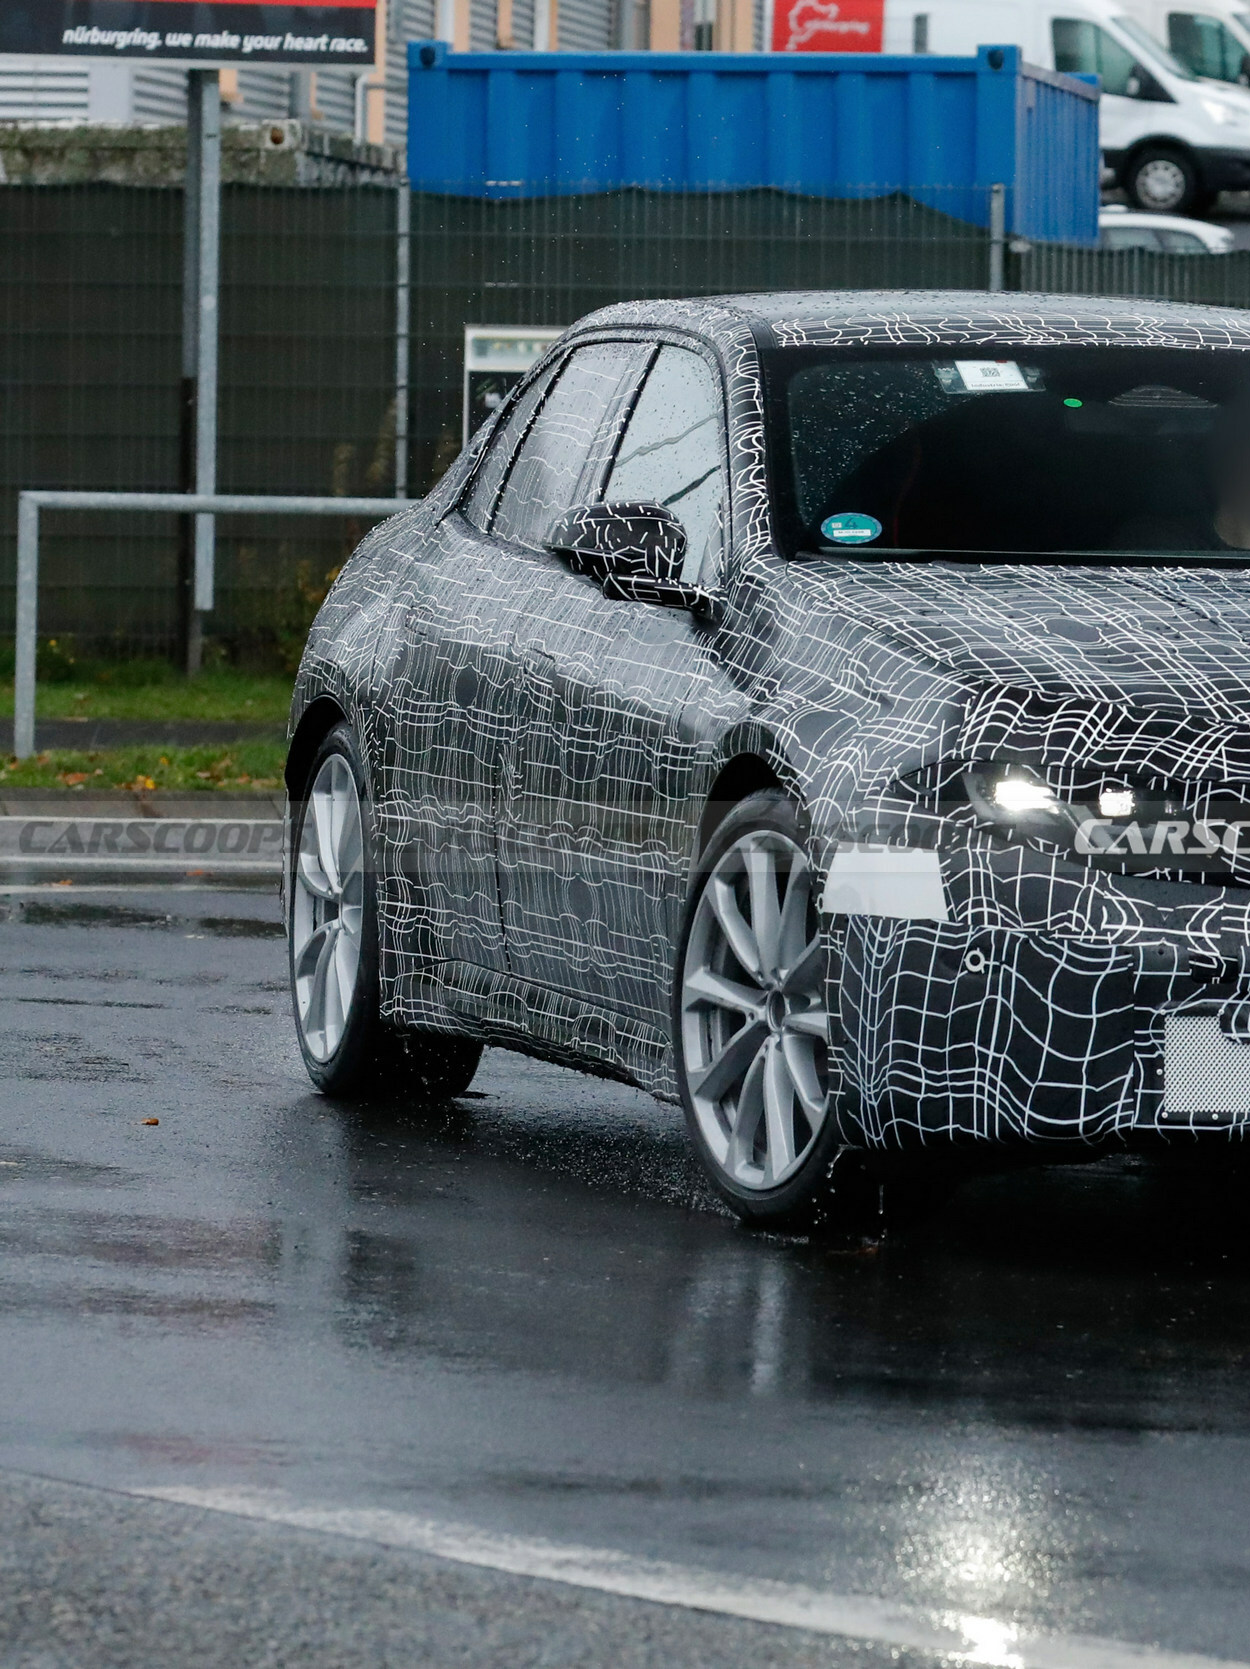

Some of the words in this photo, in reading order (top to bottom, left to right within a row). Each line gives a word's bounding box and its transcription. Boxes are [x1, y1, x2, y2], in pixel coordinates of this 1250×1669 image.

[62, 25, 163, 51] nürburgring.
[164, 32, 193, 48] we
[194, 30, 241, 49] make
[241, 34, 283, 54] your
[283, 32, 329, 52] heart
[329, 37, 369, 53] race.
